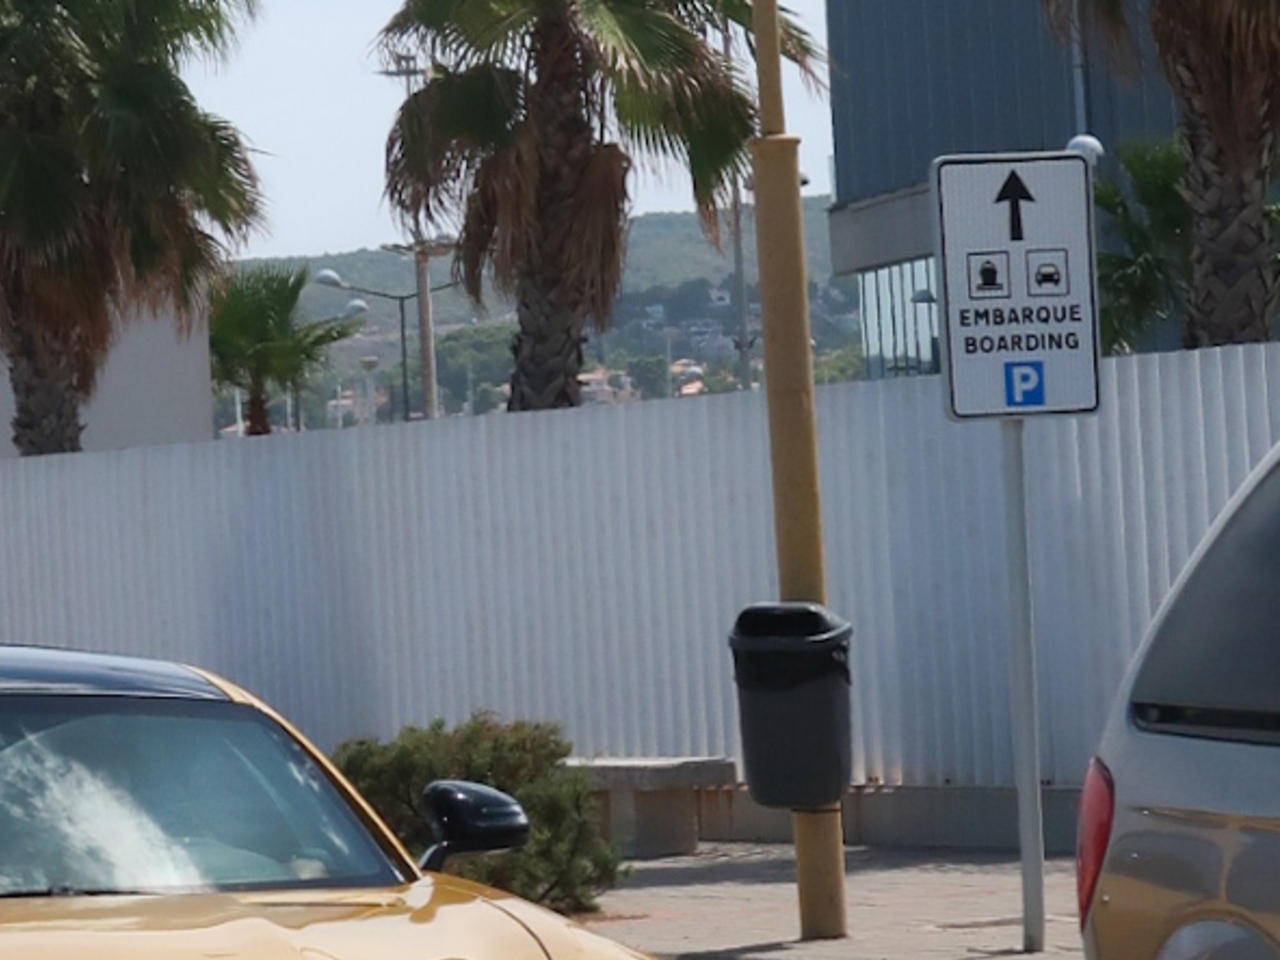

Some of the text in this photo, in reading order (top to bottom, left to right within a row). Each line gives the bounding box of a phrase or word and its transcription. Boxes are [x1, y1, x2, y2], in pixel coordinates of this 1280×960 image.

[959, 305, 1082, 327] EMBARQUE
[964, 332, 1080, 354] BOARDING
[1014, 365, 1039, 402] P
